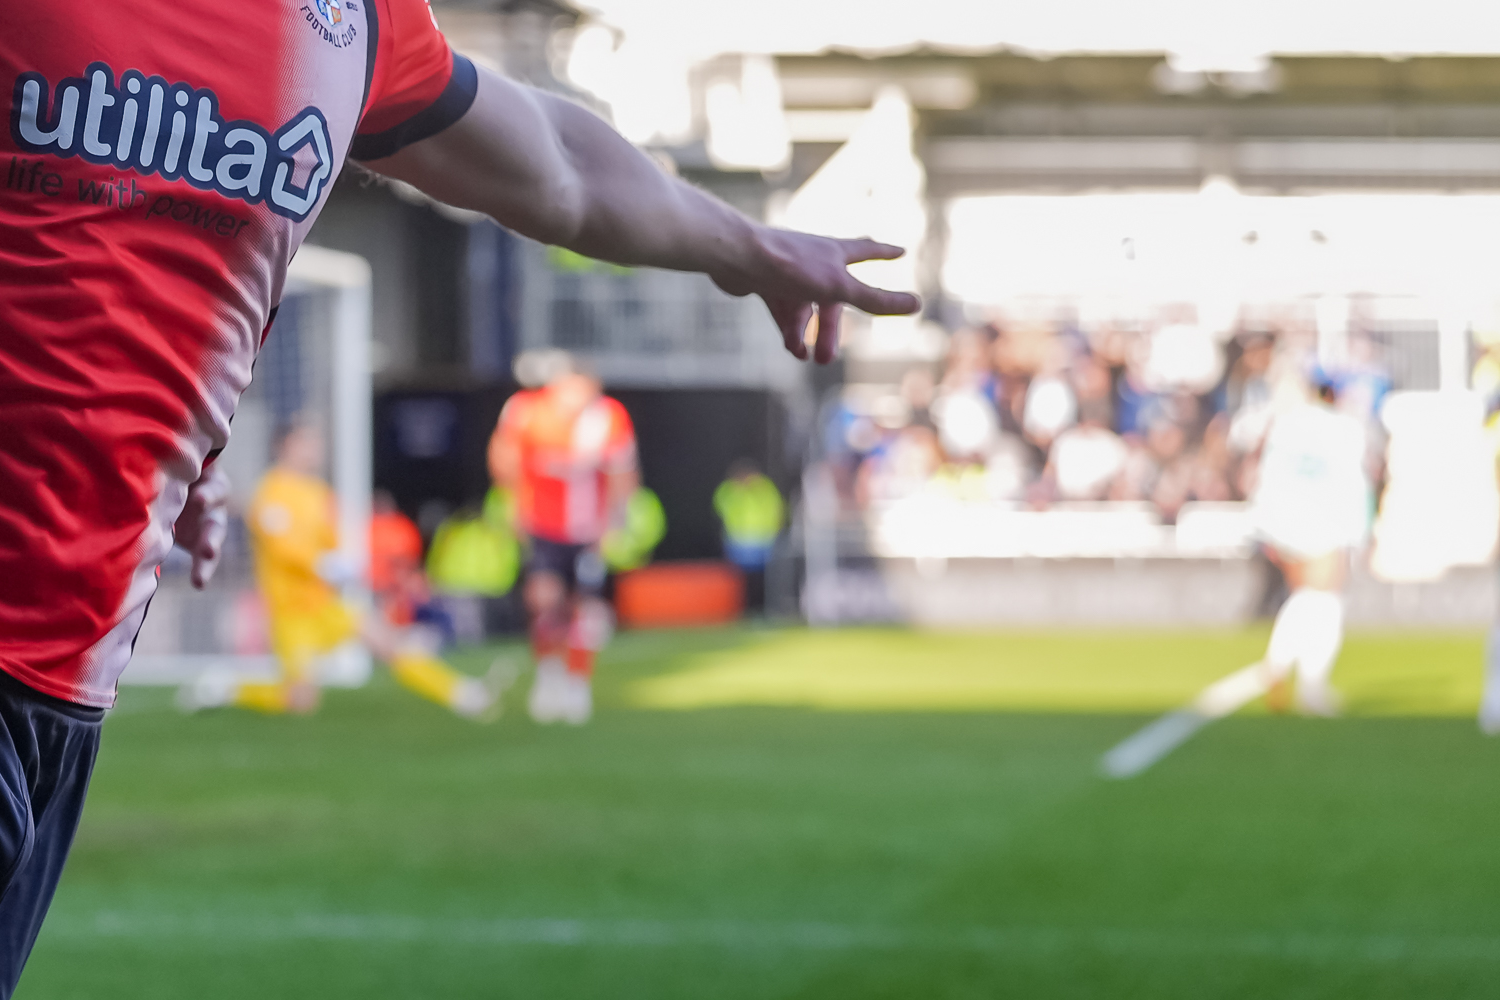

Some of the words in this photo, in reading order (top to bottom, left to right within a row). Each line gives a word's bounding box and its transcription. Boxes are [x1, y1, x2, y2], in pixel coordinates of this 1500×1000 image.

[300, 4, 343, 49] FOOTBALL
[341, 23, 357, 48] CLUB
[18, 68, 269, 198] utilita
[7, 156, 64, 197] life
[77, 175, 148, 210] with
[145, 194, 250, 239] power
